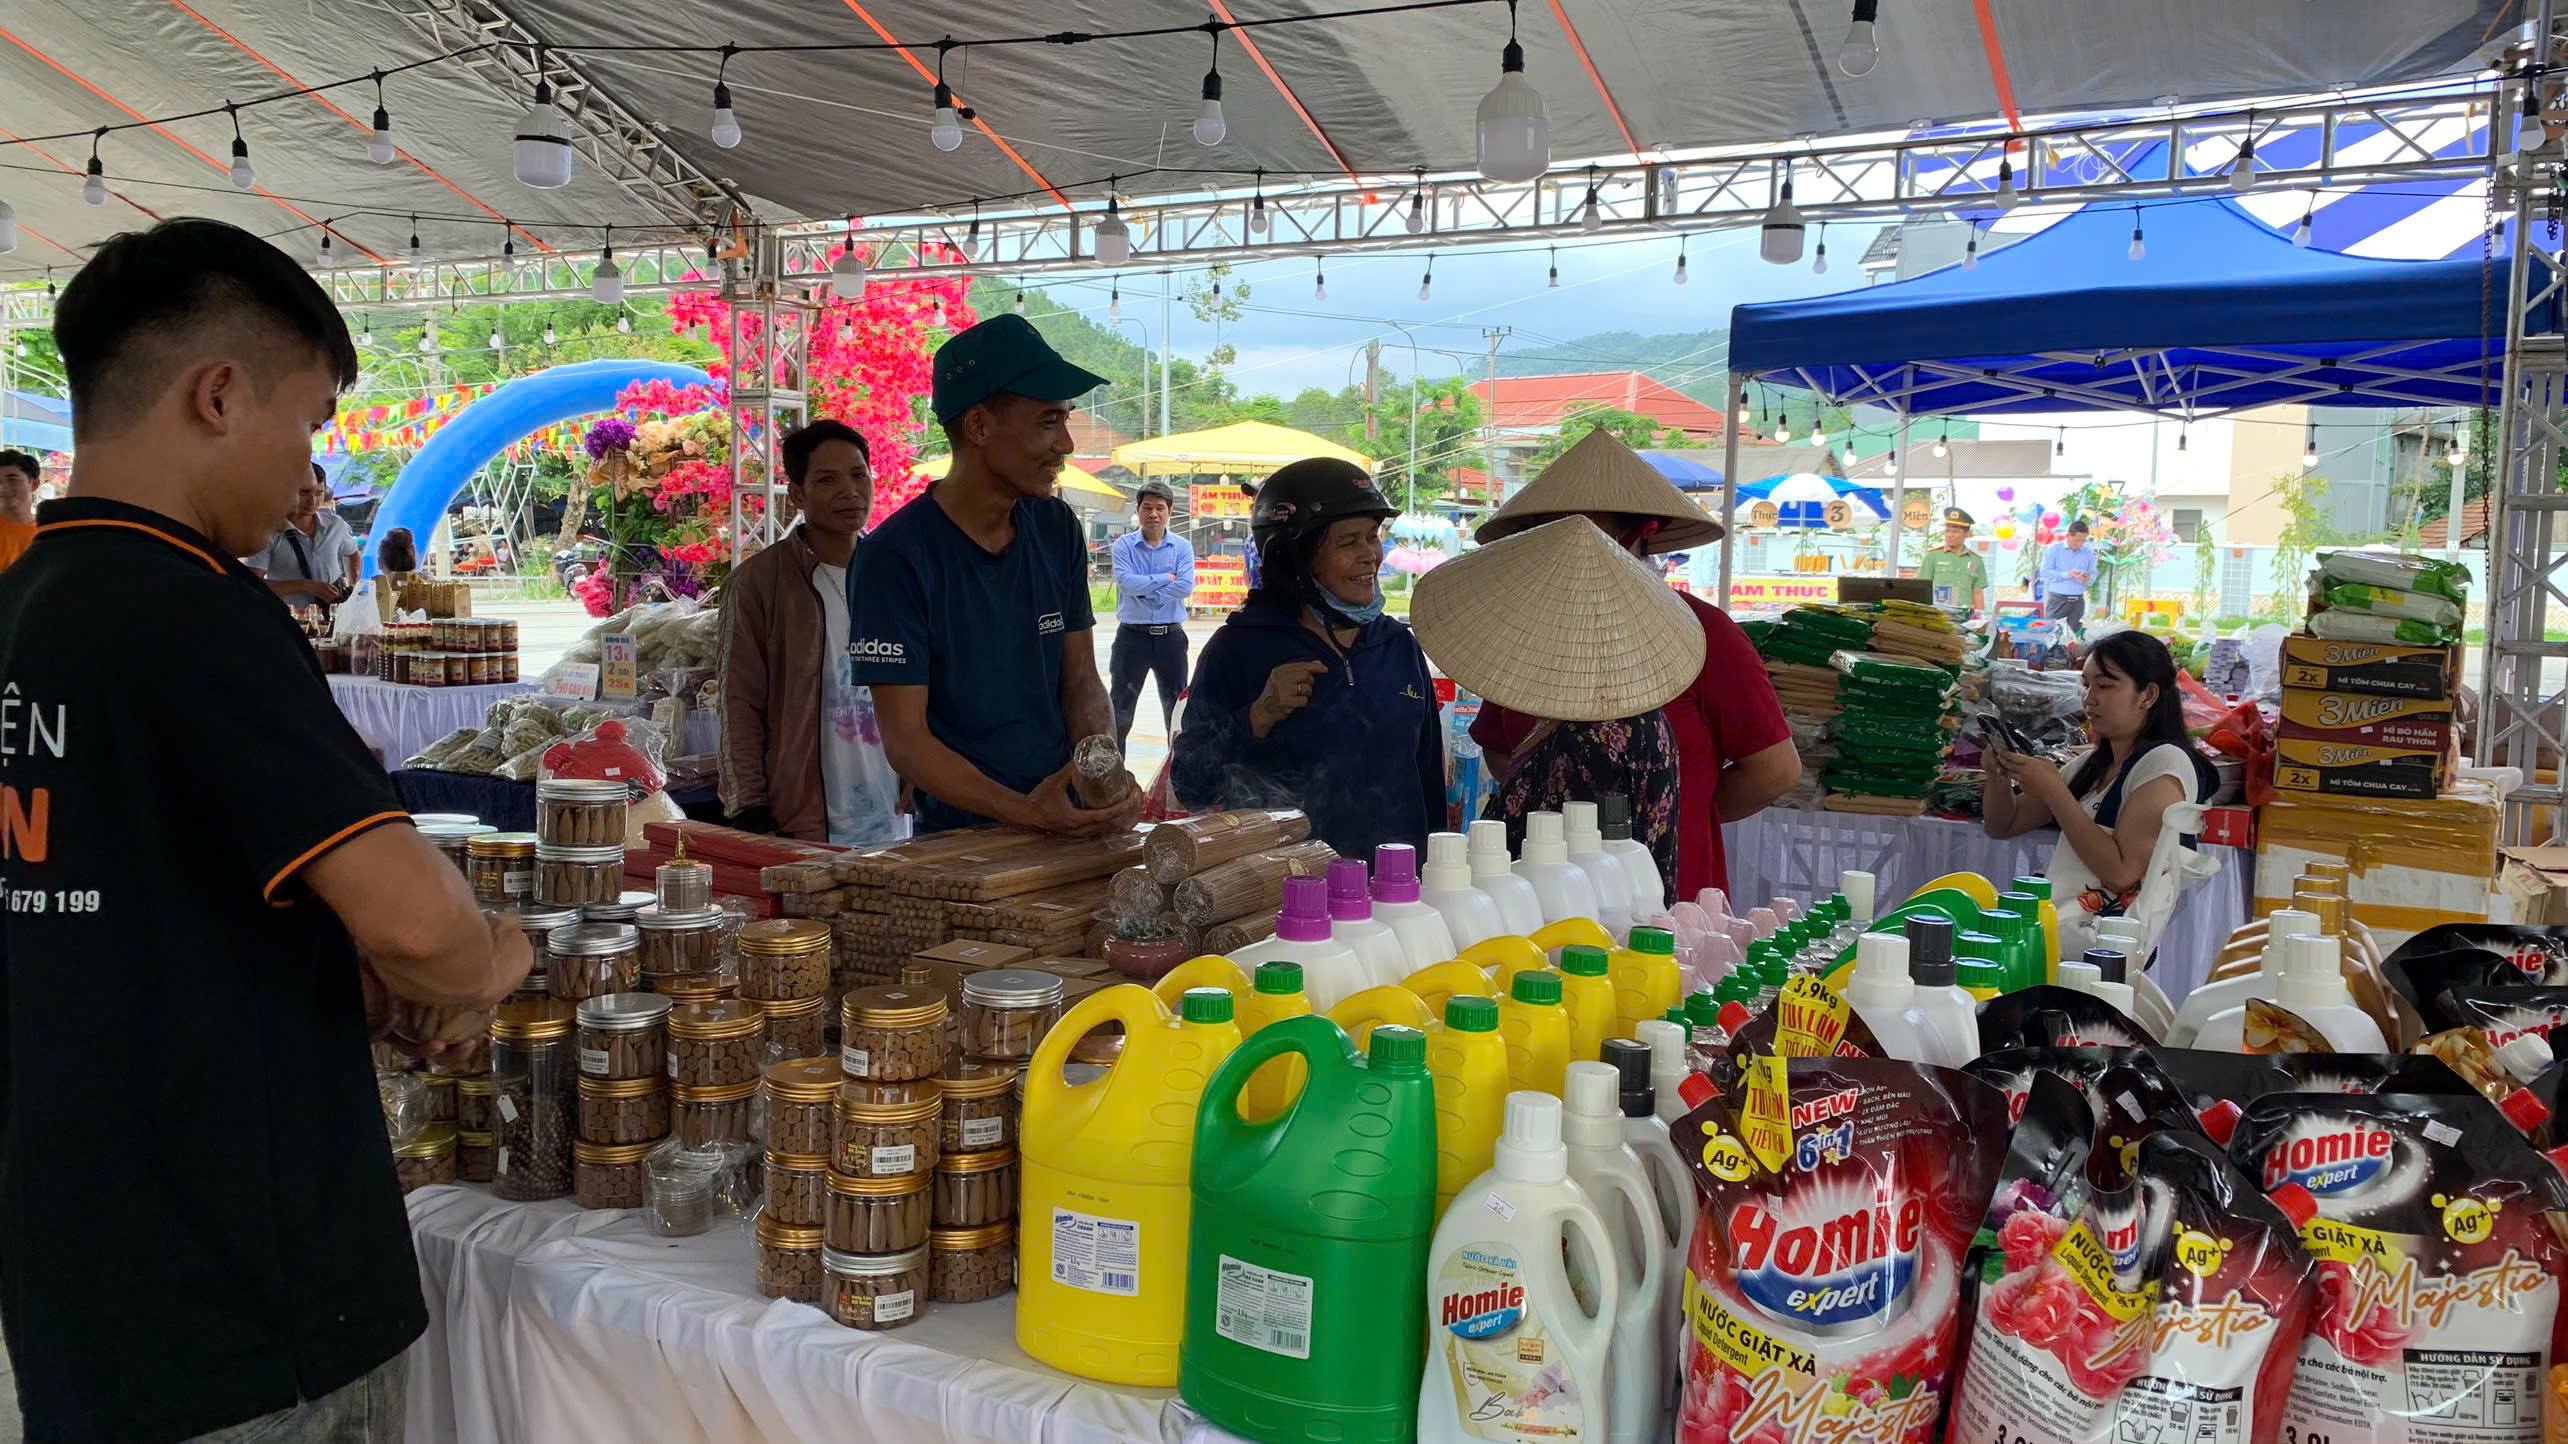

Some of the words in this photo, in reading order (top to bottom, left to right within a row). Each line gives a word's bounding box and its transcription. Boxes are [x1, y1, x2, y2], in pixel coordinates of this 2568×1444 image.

[1831, 506, 1844, 522] 3
[2397, 682, 2416, 690] CAY
[2382, 734, 2404, 744] RAU
[2389, 782, 2408, 791] CAY
[54, 889, 101, 914] 199
[1792, 977, 1838, 1009] 3,9kg
[1792, 1089, 1857, 1128] NEW
[1709, 1148, 1749, 1171] Ag+
[2263, 1126, 2392, 1191] Homie
[2307, 1164, 2359, 1190] expert
[2453, 1209, 2489, 1237] Ag+
[1728, 1198, 1922, 1277] Homie
[2312, 1225, 2357, 1250] GIẶT
[2361, 1234, 2388, 1256] XẢ
[2185, 1247, 2220, 1267] Ag+
[1442, 1282, 1525, 1327] Homie
[1787, 1271, 1879, 1317] expert
[1468, 1313, 1503, 1335] expert
[1699, 1295, 1737, 1339] NƯỚC
[1739, 1329, 1786, 1364] GIẶT
[1787, 1350, 1817, 1377] XẢ
[1713, 1332, 1749, 1367] Detergent
[2038, 1368, 2054, 1383] cho
[2307, 1357, 2324, 1369] cho
[2324, 1363, 2341, 1374] các
